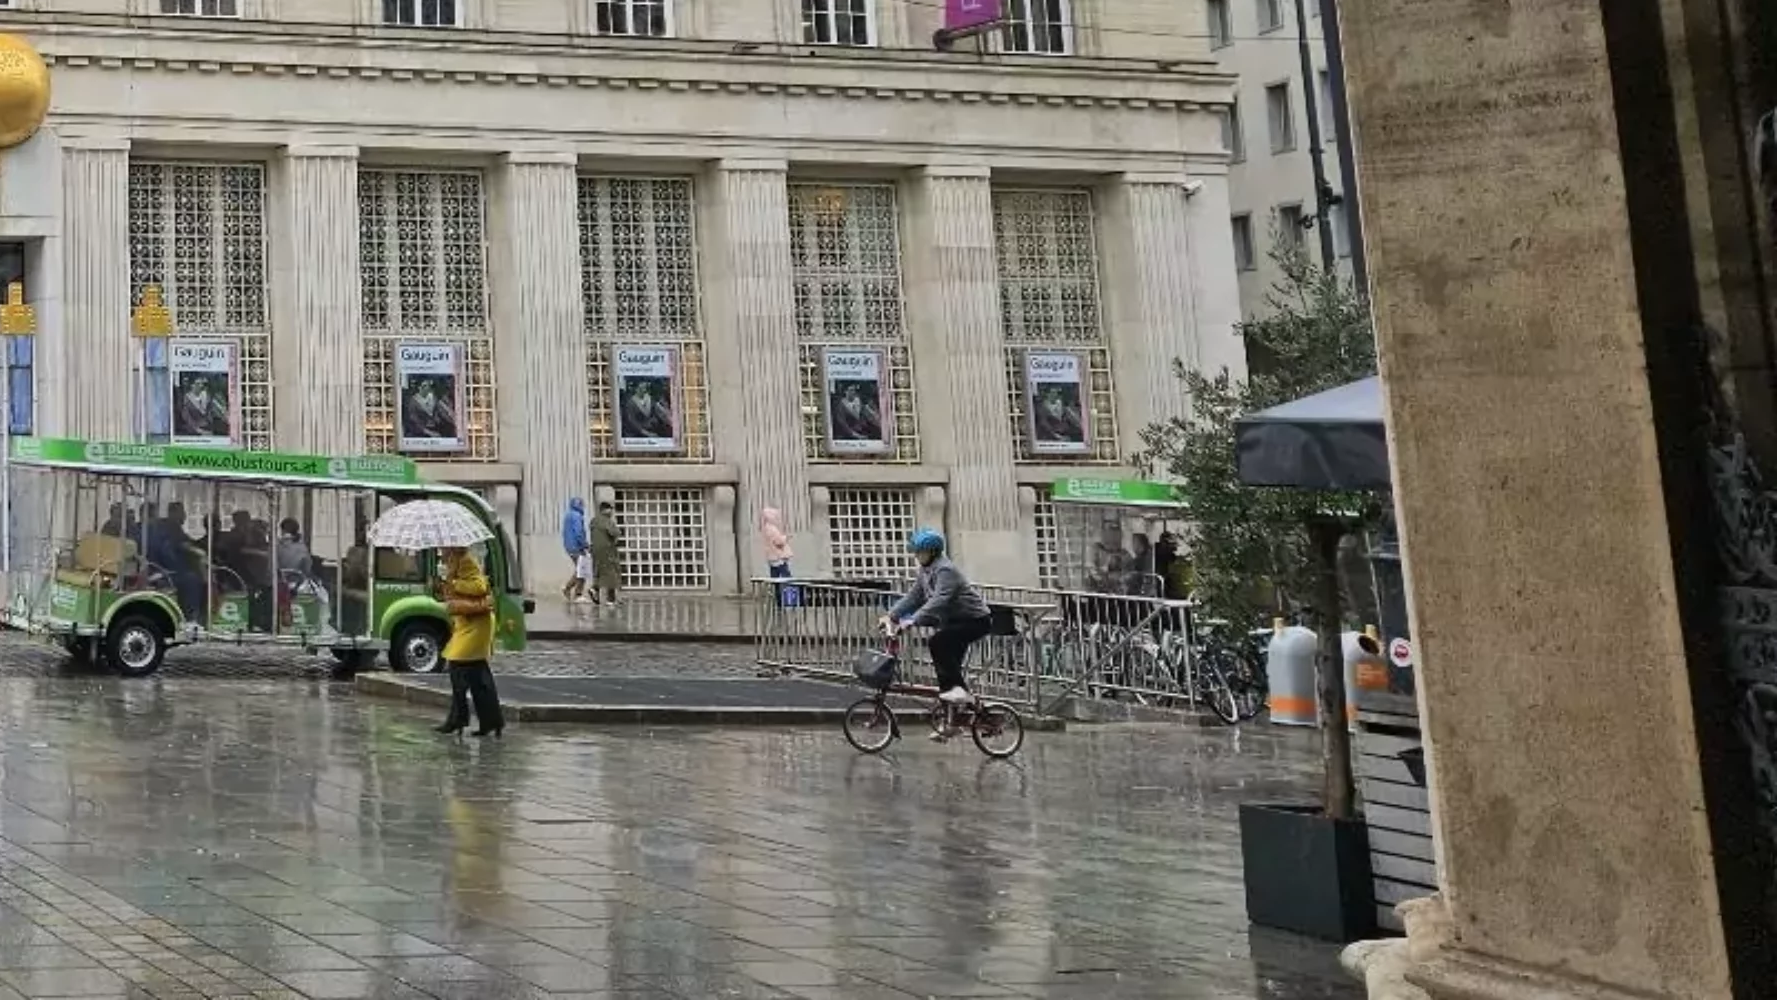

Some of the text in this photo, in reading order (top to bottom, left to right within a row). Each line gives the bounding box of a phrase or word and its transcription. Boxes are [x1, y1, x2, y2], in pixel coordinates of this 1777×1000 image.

[174, 345, 225, 361] Gauguin
[401, 348, 450, 363] Gauguin
[176, 452, 319, 475] www.ebustours.at
